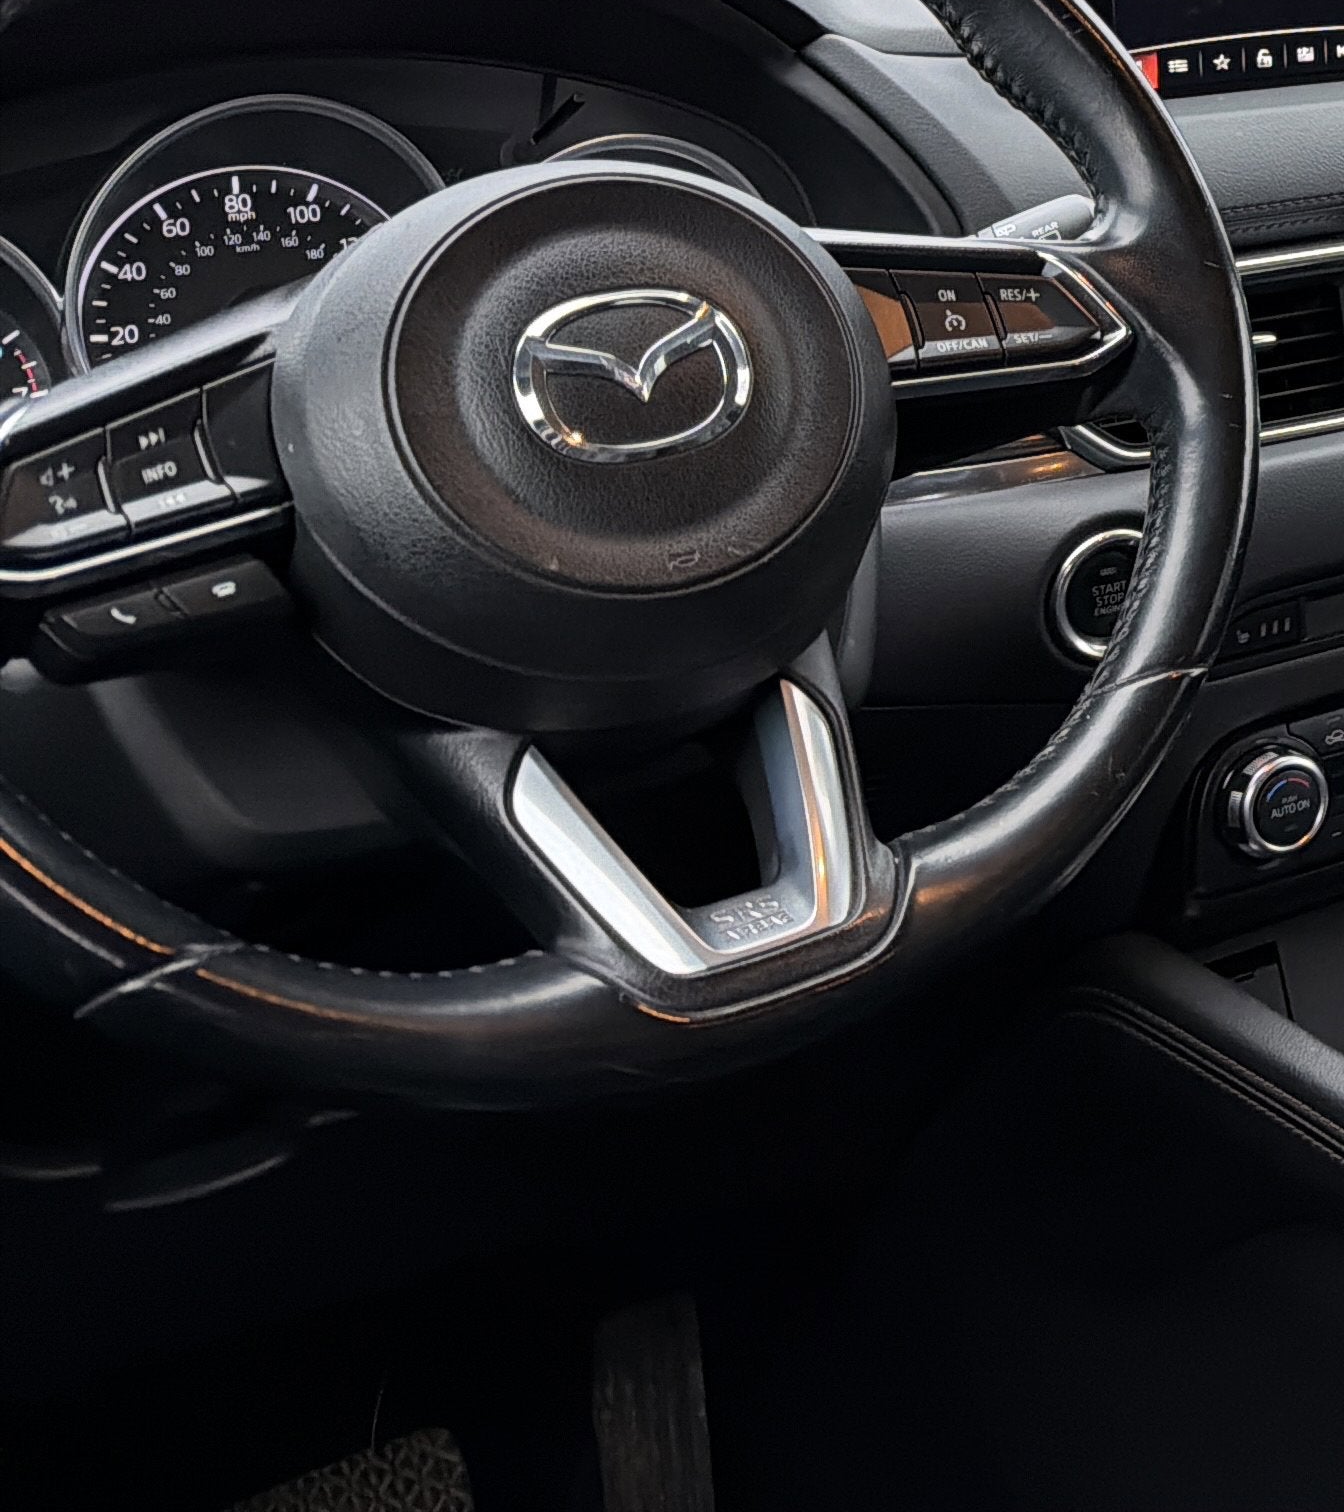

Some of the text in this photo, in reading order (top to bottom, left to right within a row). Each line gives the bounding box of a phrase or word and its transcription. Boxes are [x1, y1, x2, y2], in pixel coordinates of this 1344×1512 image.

[224, 193, 252, 213] 80
[227, 210, 256, 223] mph
[287, 204, 321, 223] 100
[162, 218, 190, 238] 60
[1031, 221, 1059, 238] REAR
[223, 233, 242, 246] 120
[252, 230, 271, 242] 140
[280, 236, 299, 248] 160
[195, 245, 214, 257] 100
[235, 242, 260, 254] km/h
[305, 248, 325, 260] 180
[118, 262, 146, 282] 40
[174, 264, 191, 276] 80
[160, 287, 176, 299] 60
[938, 289, 957, 302] ON
[155, 313, 171, 326] 40
[110, 325, 139, 346] 20
[936, 338, 988, 353] OFF/CAN
[141, 461, 178, 485] INFO
[1092, 580, 1127, 597] START
[1096, 592, 1125, 607] STOP
[1093, 604, 1120, 617] ENGIN
[1271, 799, 1311, 819] AUTO ON
